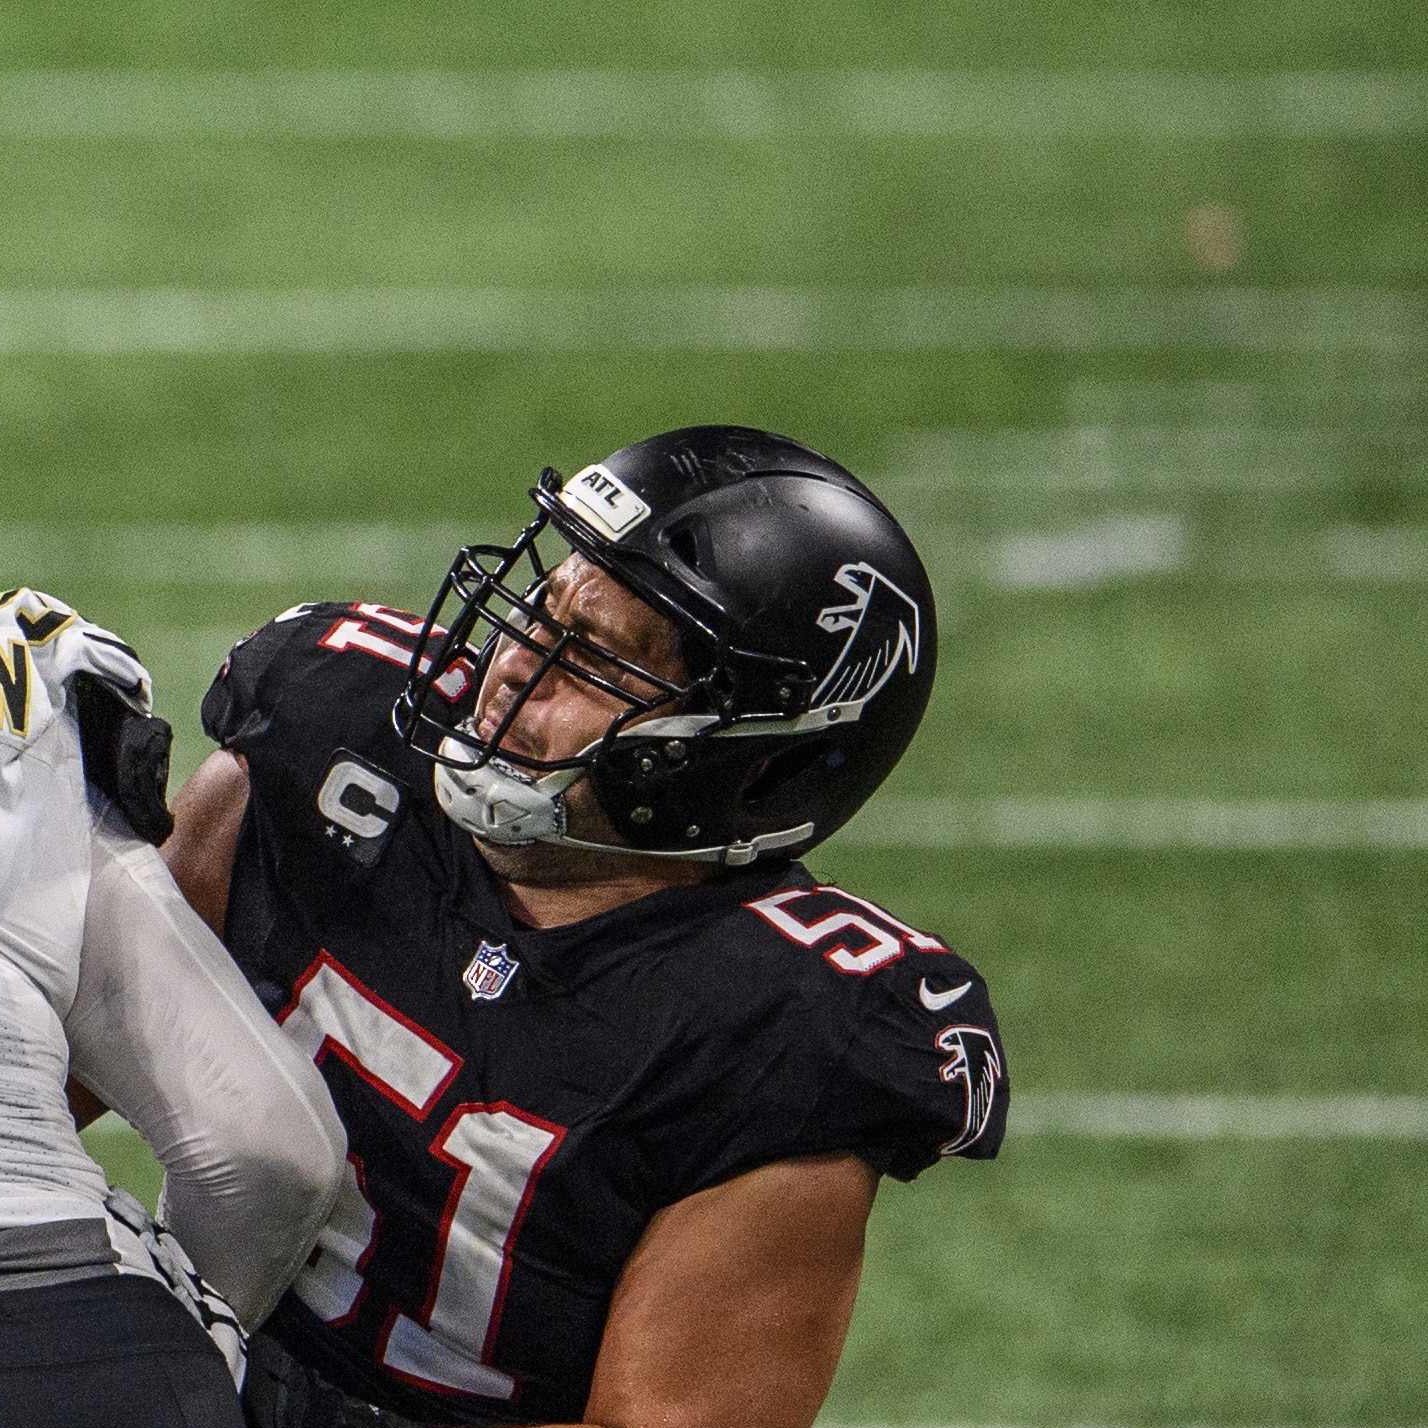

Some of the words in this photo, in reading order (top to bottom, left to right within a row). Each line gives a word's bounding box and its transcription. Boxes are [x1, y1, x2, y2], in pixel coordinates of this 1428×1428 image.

[581, 471, 624, 509] ATL
[318, 761, 400, 839] C
[741, 885, 950, 977] 51
[470, 963, 499, 992] NFL
